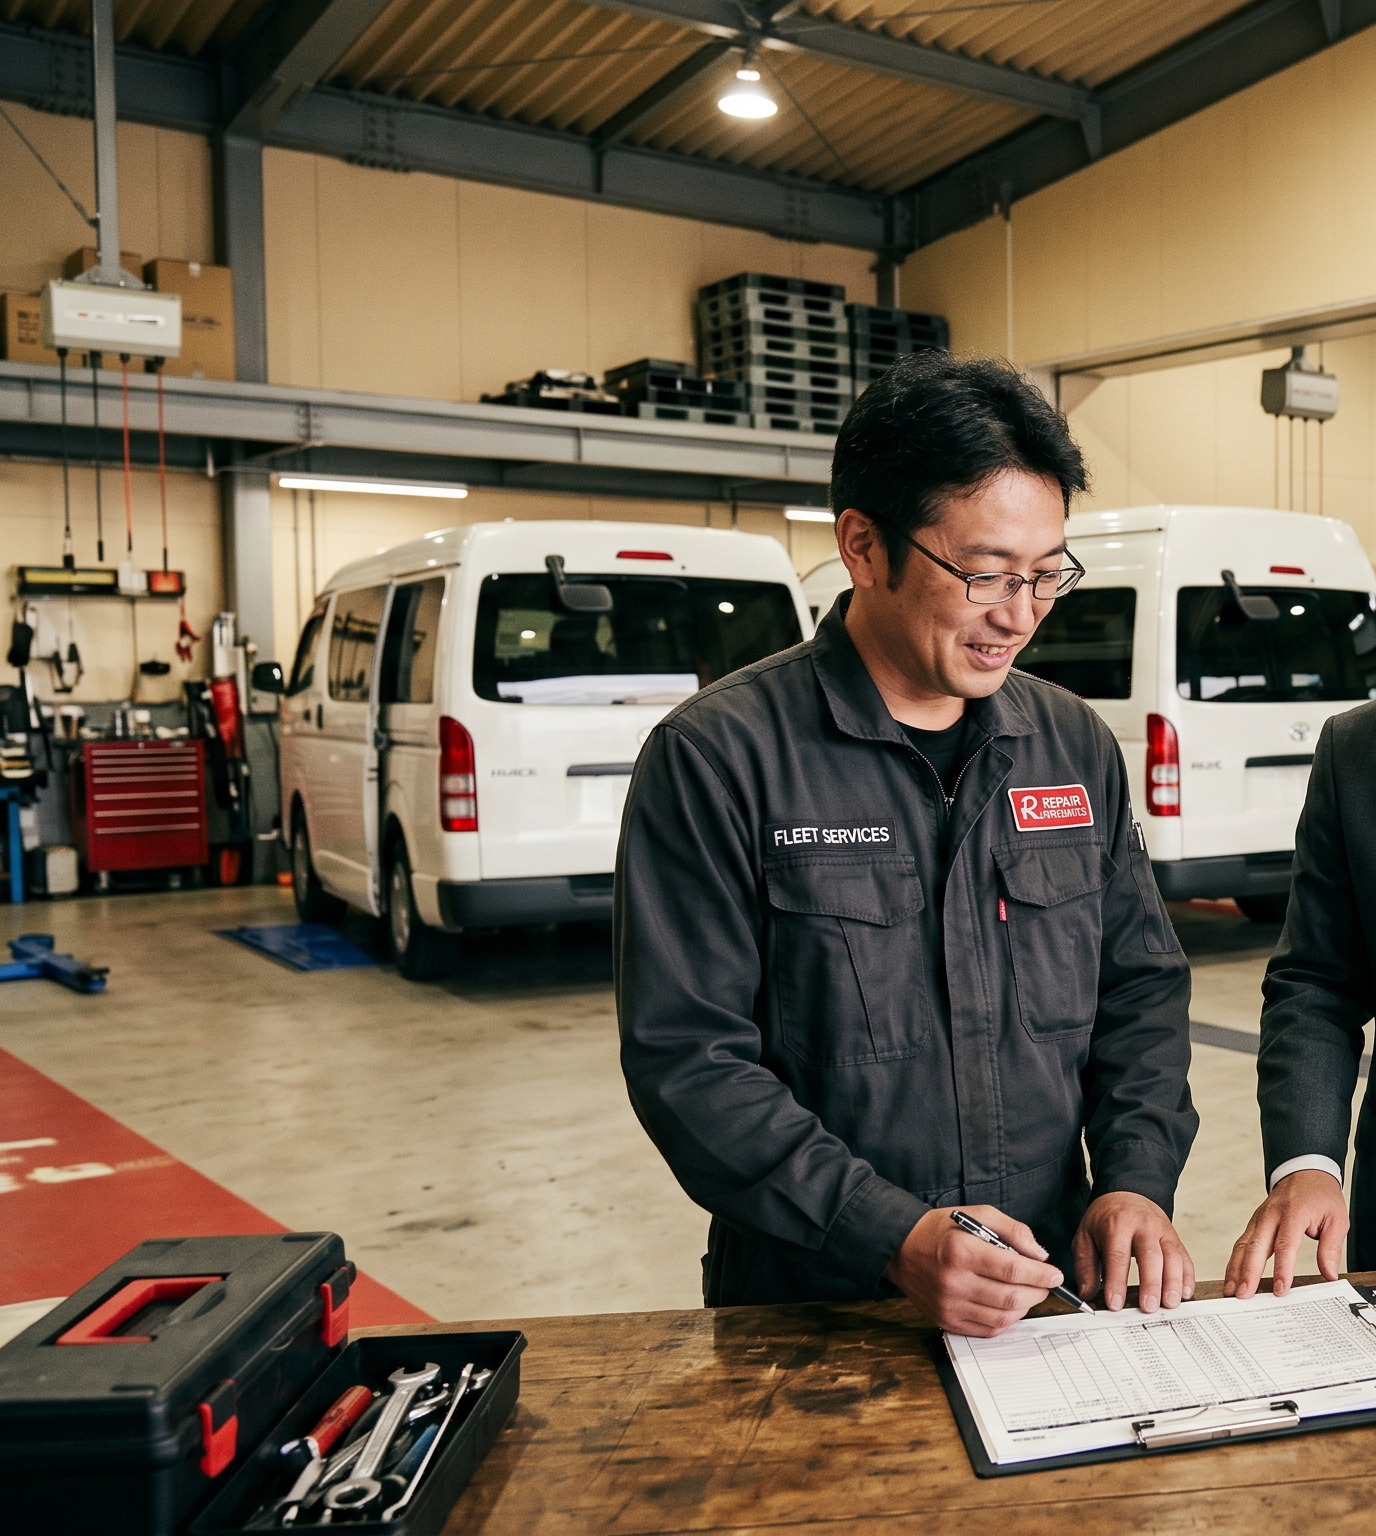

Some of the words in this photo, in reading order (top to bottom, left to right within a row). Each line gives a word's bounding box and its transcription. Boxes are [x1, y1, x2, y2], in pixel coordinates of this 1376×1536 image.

[1041, 795, 1082, 809] REPAIR
[773, 827, 819, 847] FLEET
[822, 826, 891, 845] SERVICES
